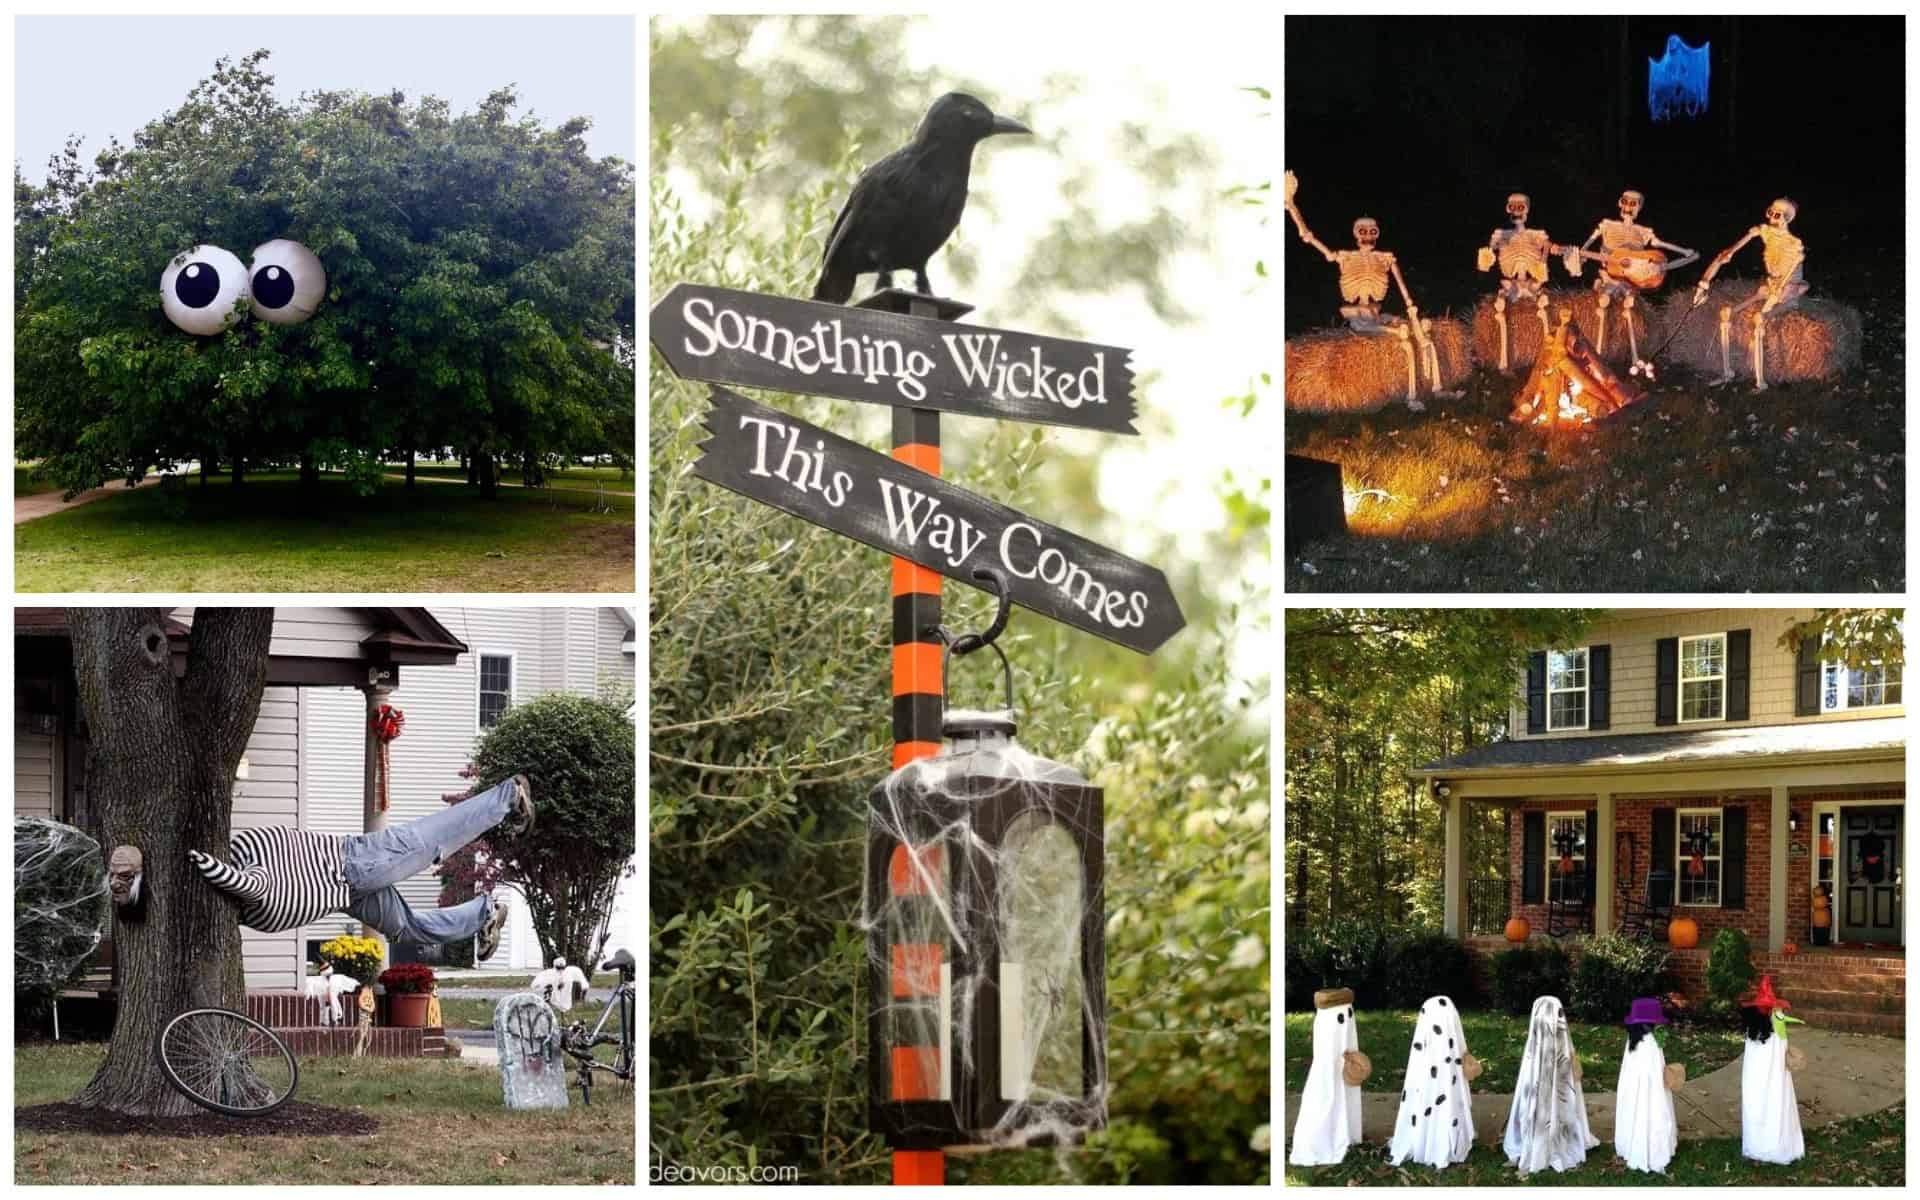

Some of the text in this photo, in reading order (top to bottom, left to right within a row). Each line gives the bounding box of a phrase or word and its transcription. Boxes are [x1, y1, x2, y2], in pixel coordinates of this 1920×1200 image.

[682, 297, 1107, 408] Something Wicked
[739, 416, 1148, 628] This Way Comes
